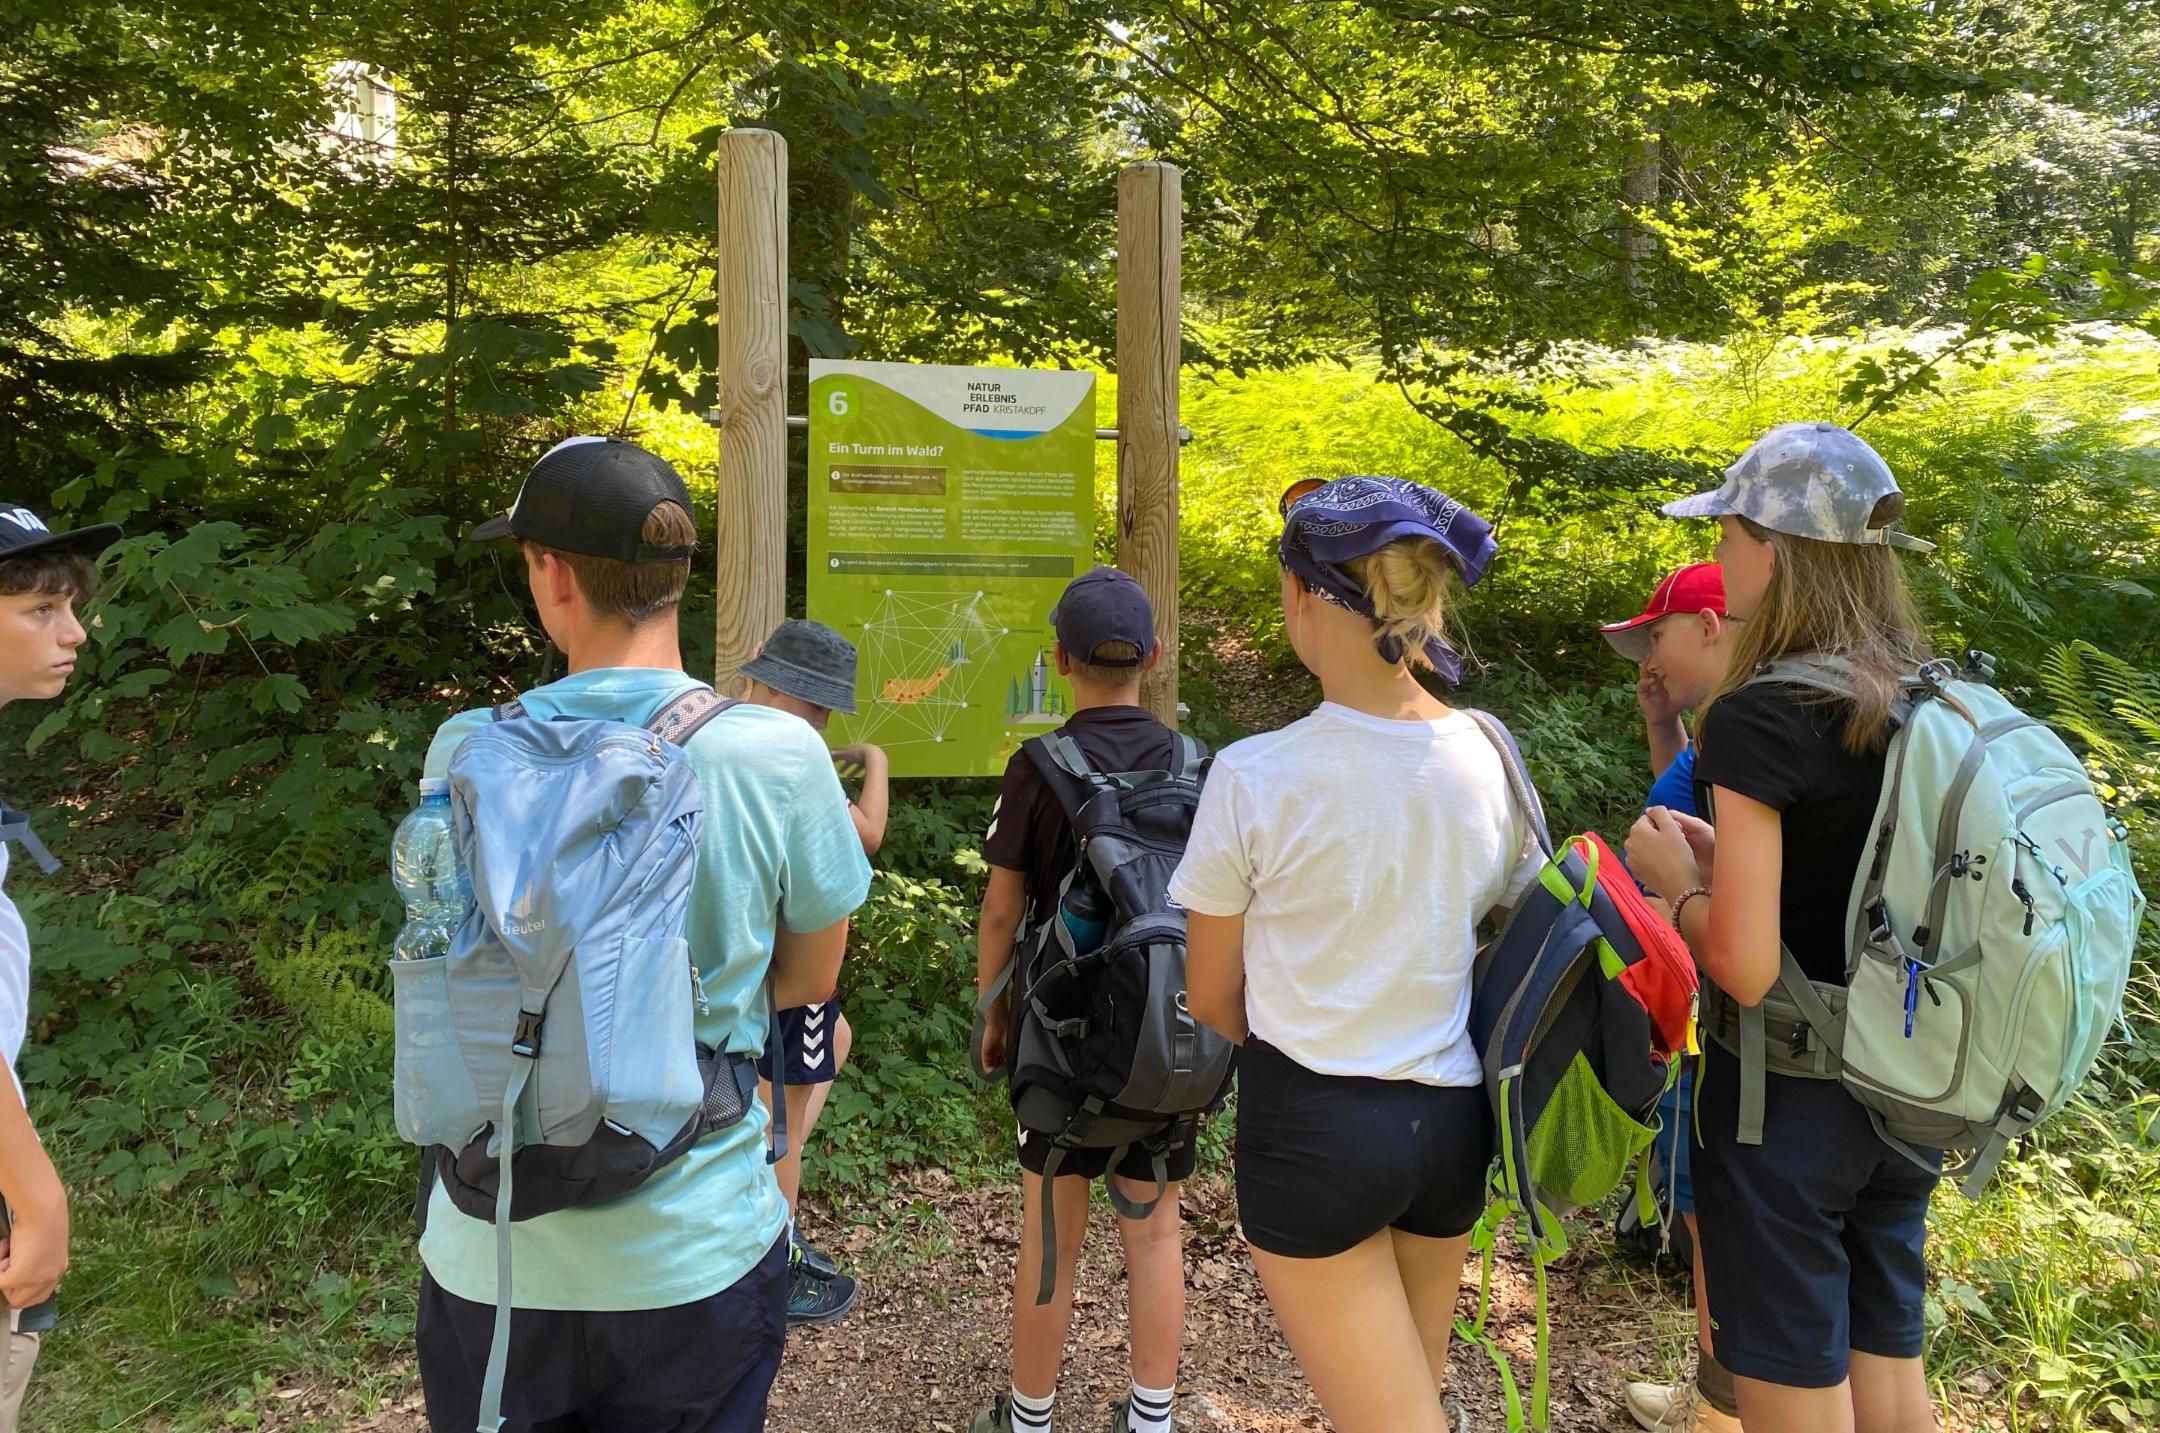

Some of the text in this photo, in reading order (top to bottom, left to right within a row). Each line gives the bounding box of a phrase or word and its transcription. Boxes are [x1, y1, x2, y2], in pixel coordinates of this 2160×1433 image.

[967, 382, 1001, 392] NATUR
[828, 390, 848, 416] 6
[970, 393, 1017, 404] ERLEBNIS
[963, 403, 1046, 415] PFAD KRISTAKOPF
[828, 442, 944, 457] Ein Turm im Wald?
